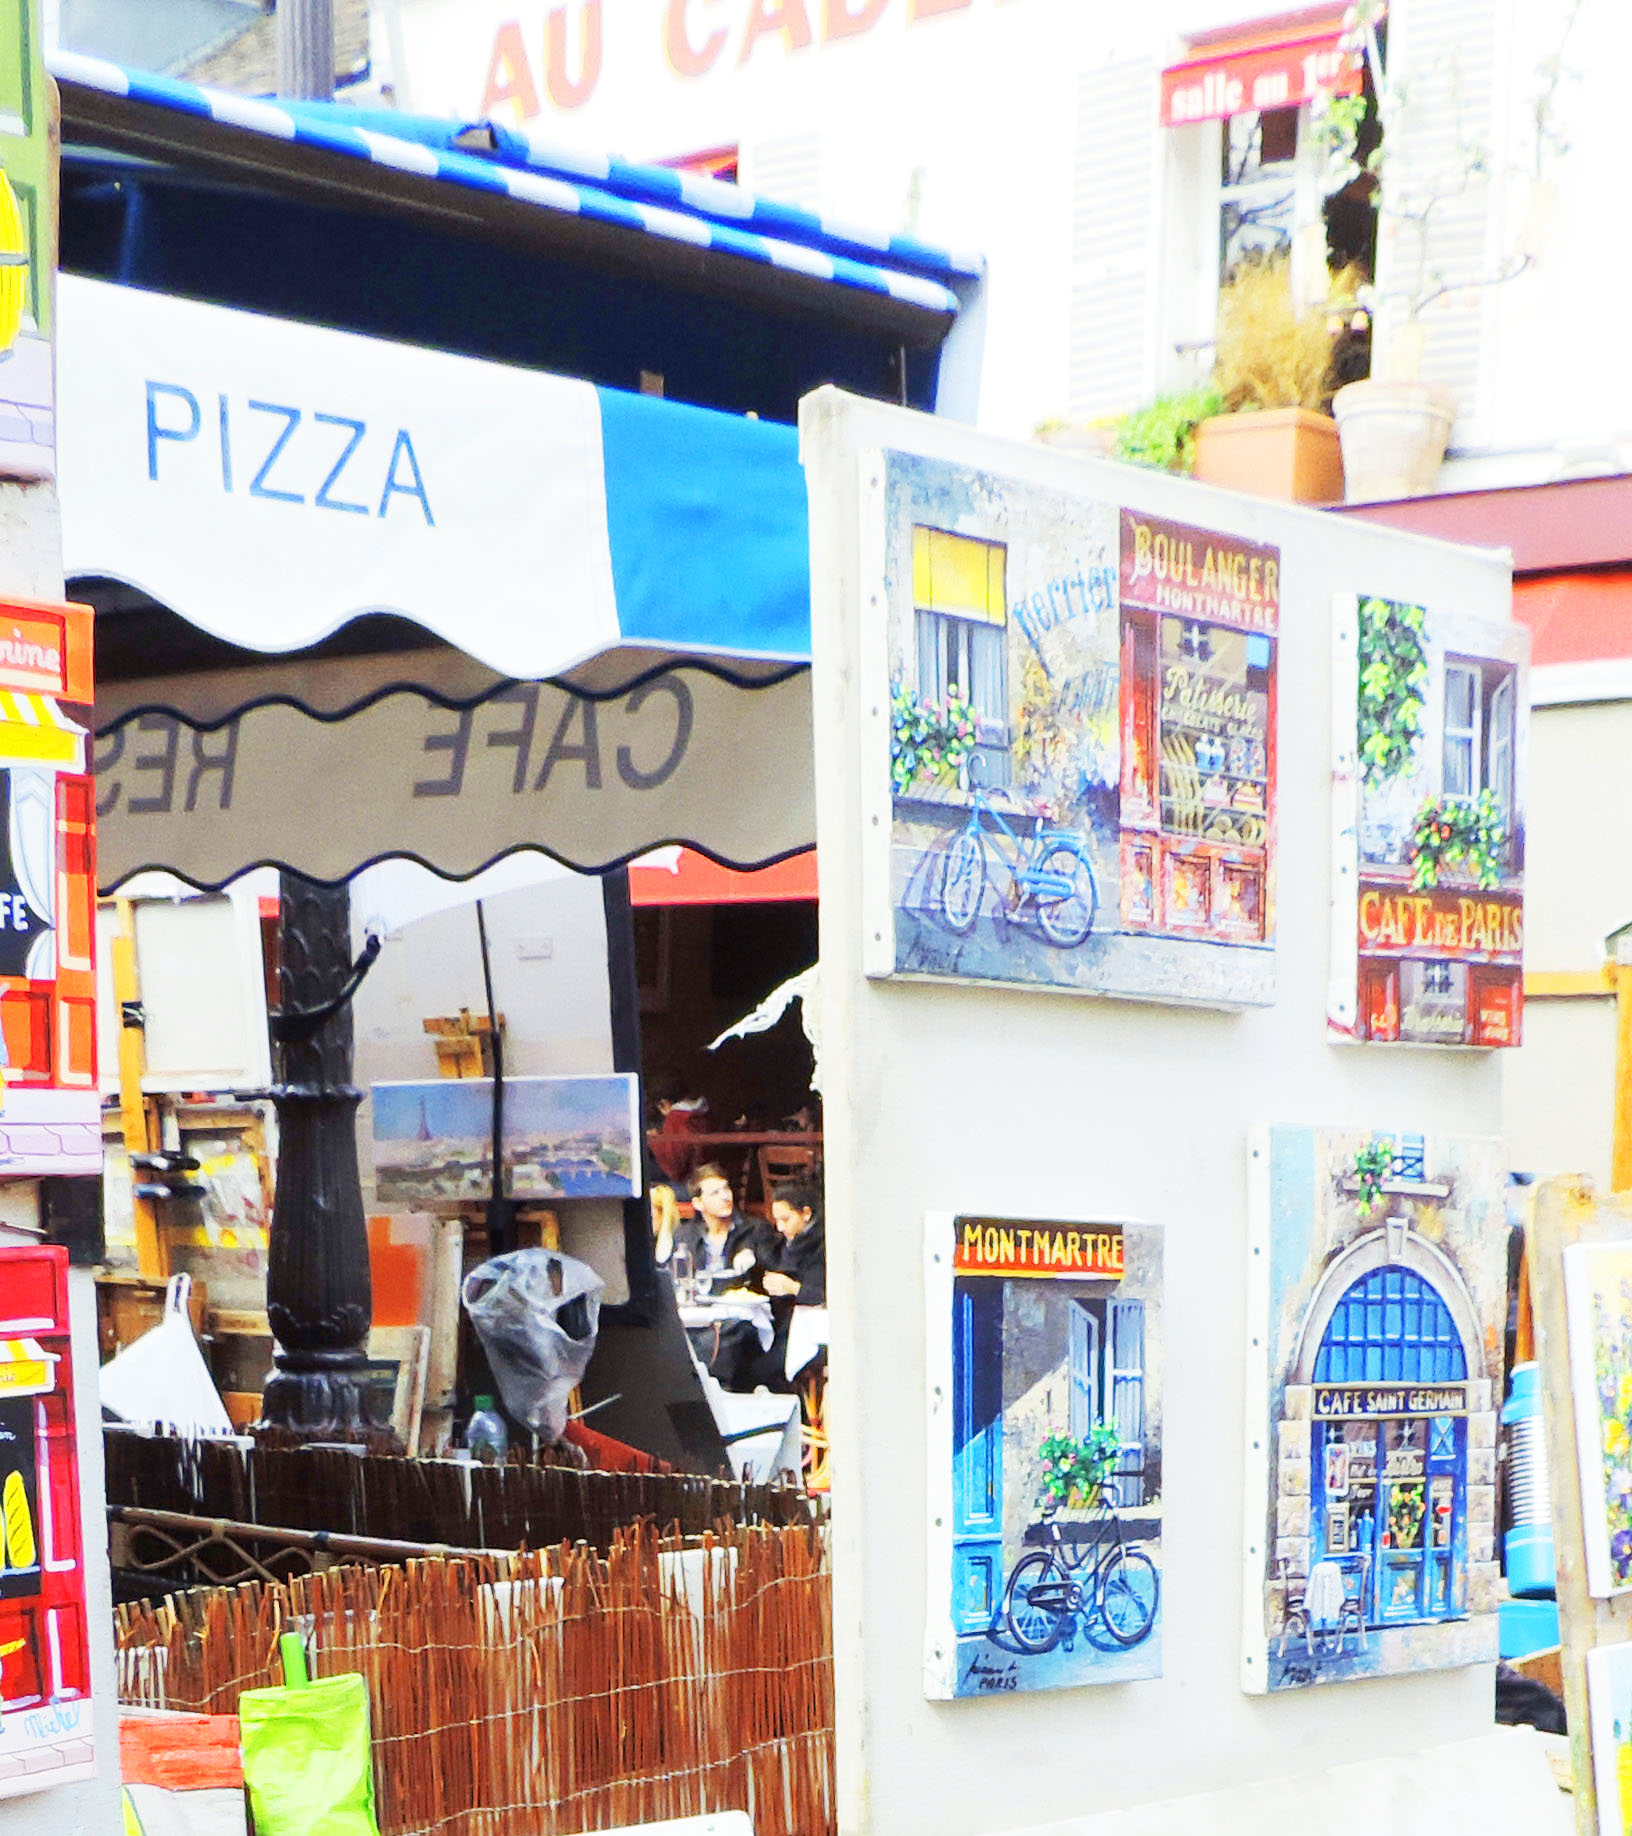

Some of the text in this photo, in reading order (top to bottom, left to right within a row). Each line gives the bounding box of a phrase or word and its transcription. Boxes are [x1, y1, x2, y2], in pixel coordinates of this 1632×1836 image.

[480, 0, 603, 121] AU
[144, 379, 436, 528] PIZZA
[1127, 516, 1280, 604] BOULANGER
[1360, 890, 1433, 946] CAFE
[1459, 897, 1524, 951] PARIS
[962, 1223, 1124, 1269] MONTMARTRE
[1318, 1389, 1465, 1415] CAFE SAINT GERMAIN
